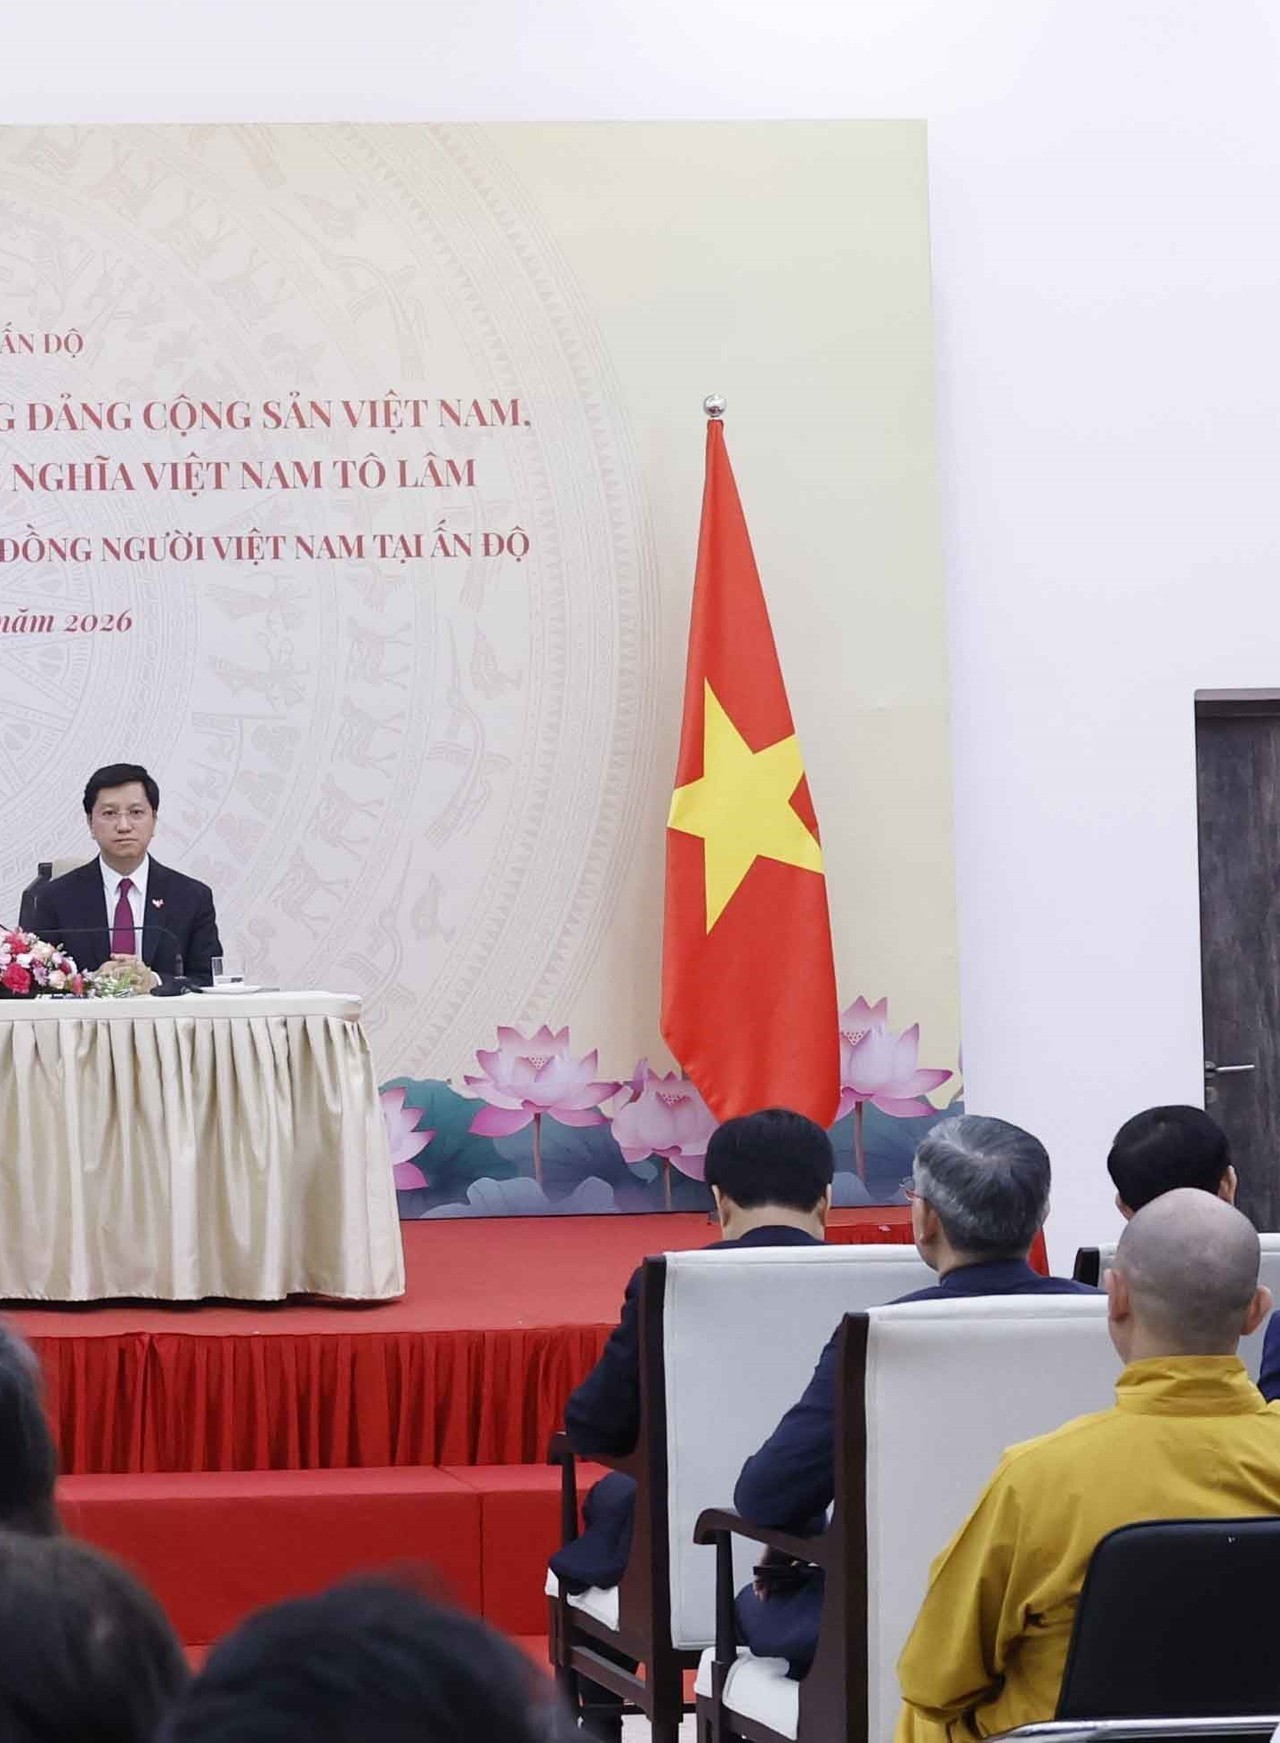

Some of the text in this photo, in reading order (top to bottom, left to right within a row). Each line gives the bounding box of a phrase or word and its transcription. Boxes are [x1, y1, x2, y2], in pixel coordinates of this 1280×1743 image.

[0, 321, 34, 354] ẤN
[142, 394, 252, 437] CỘNG
[262, 391, 332, 429] SẢN
[339, 388, 428, 434] VIỆT
[438, 398, 531, 428] NAM,
[11, 455, 135, 491] NGHĨA
[142, 451, 230, 496] VIỆT
[240, 460, 322, 490] NAM
[332, 451, 387, 489] TÔ
[397, 452, 476, 488] LÂM
[101, 530, 205, 562] NGƯỜI
[212, 527, 286, 566] VIỆT
[294, 534, 365, 560] NAM
[372, 533, 423, 564] TẠI
[429, 519, 472, 559] ẤN
[480, 526, 530, 563] ĐỘ
[63, 608, 133, 633] 2026
